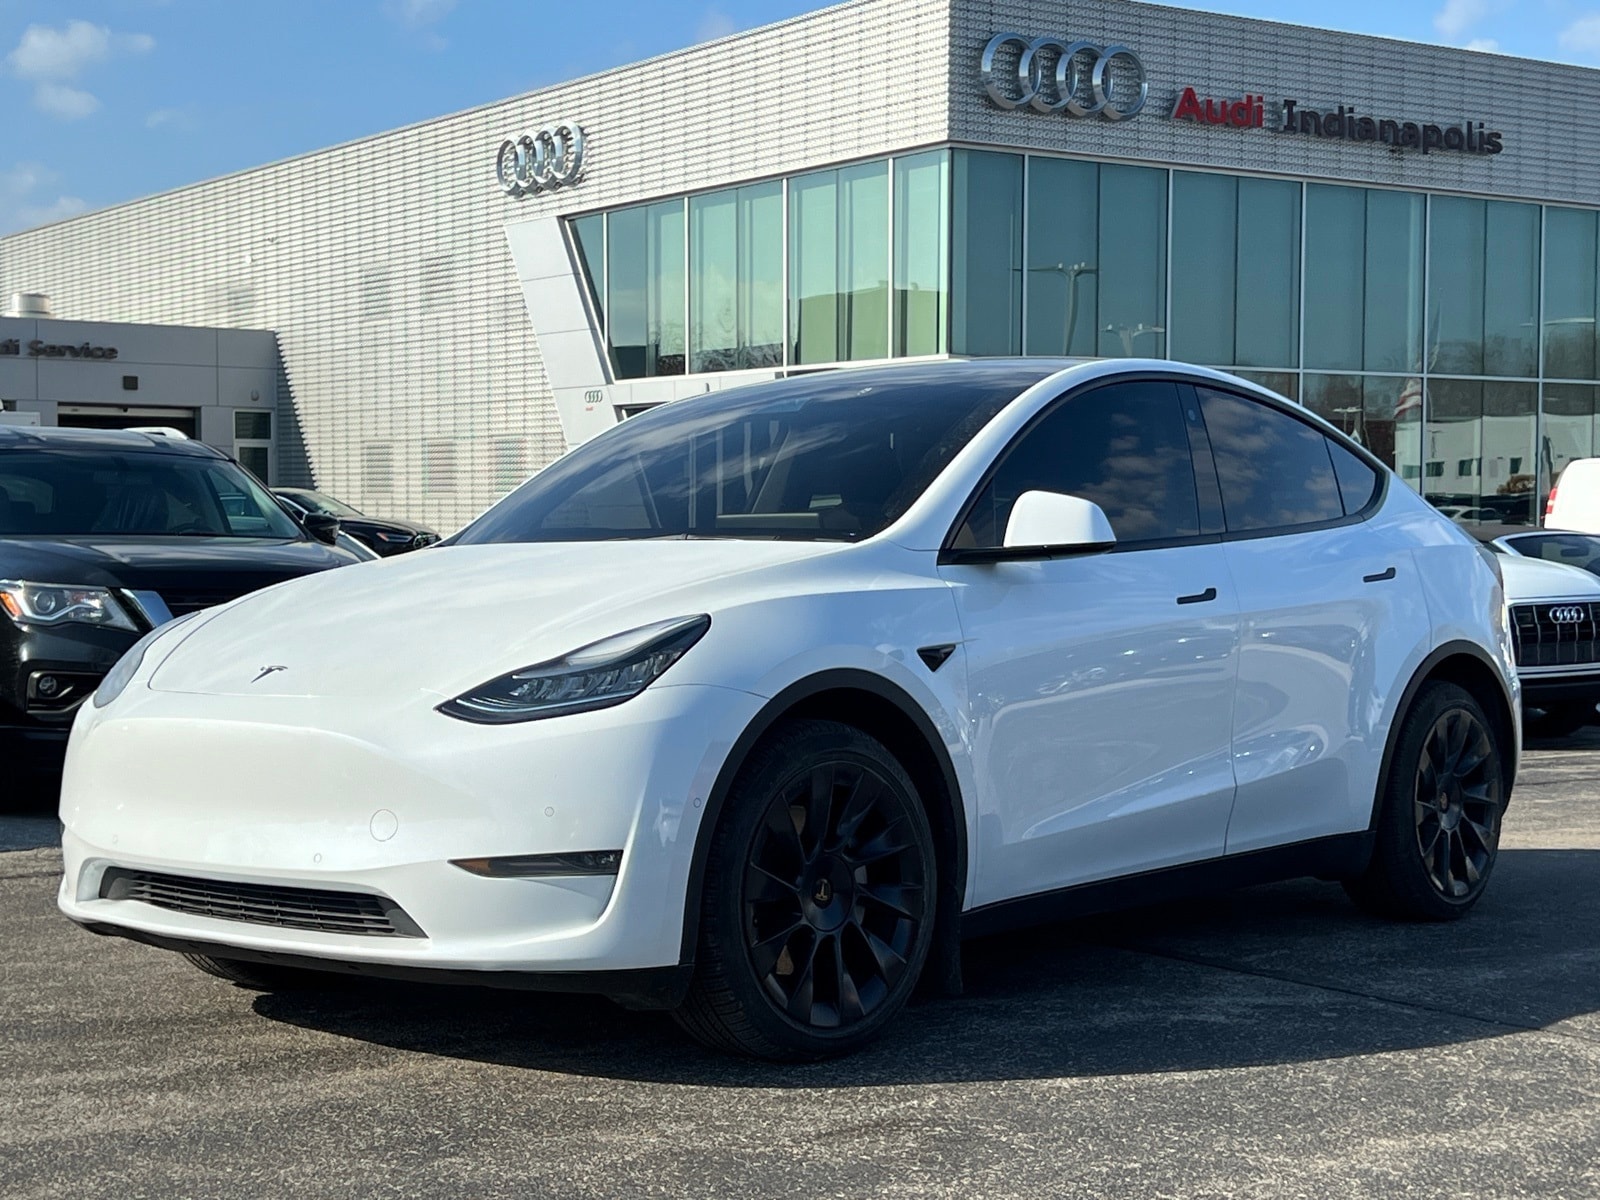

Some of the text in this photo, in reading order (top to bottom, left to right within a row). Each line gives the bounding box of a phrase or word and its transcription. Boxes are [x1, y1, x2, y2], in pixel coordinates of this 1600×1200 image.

[1173, 86, 1503, 154] Audi Indianapolis
[28, 340, 118, 359] Service
